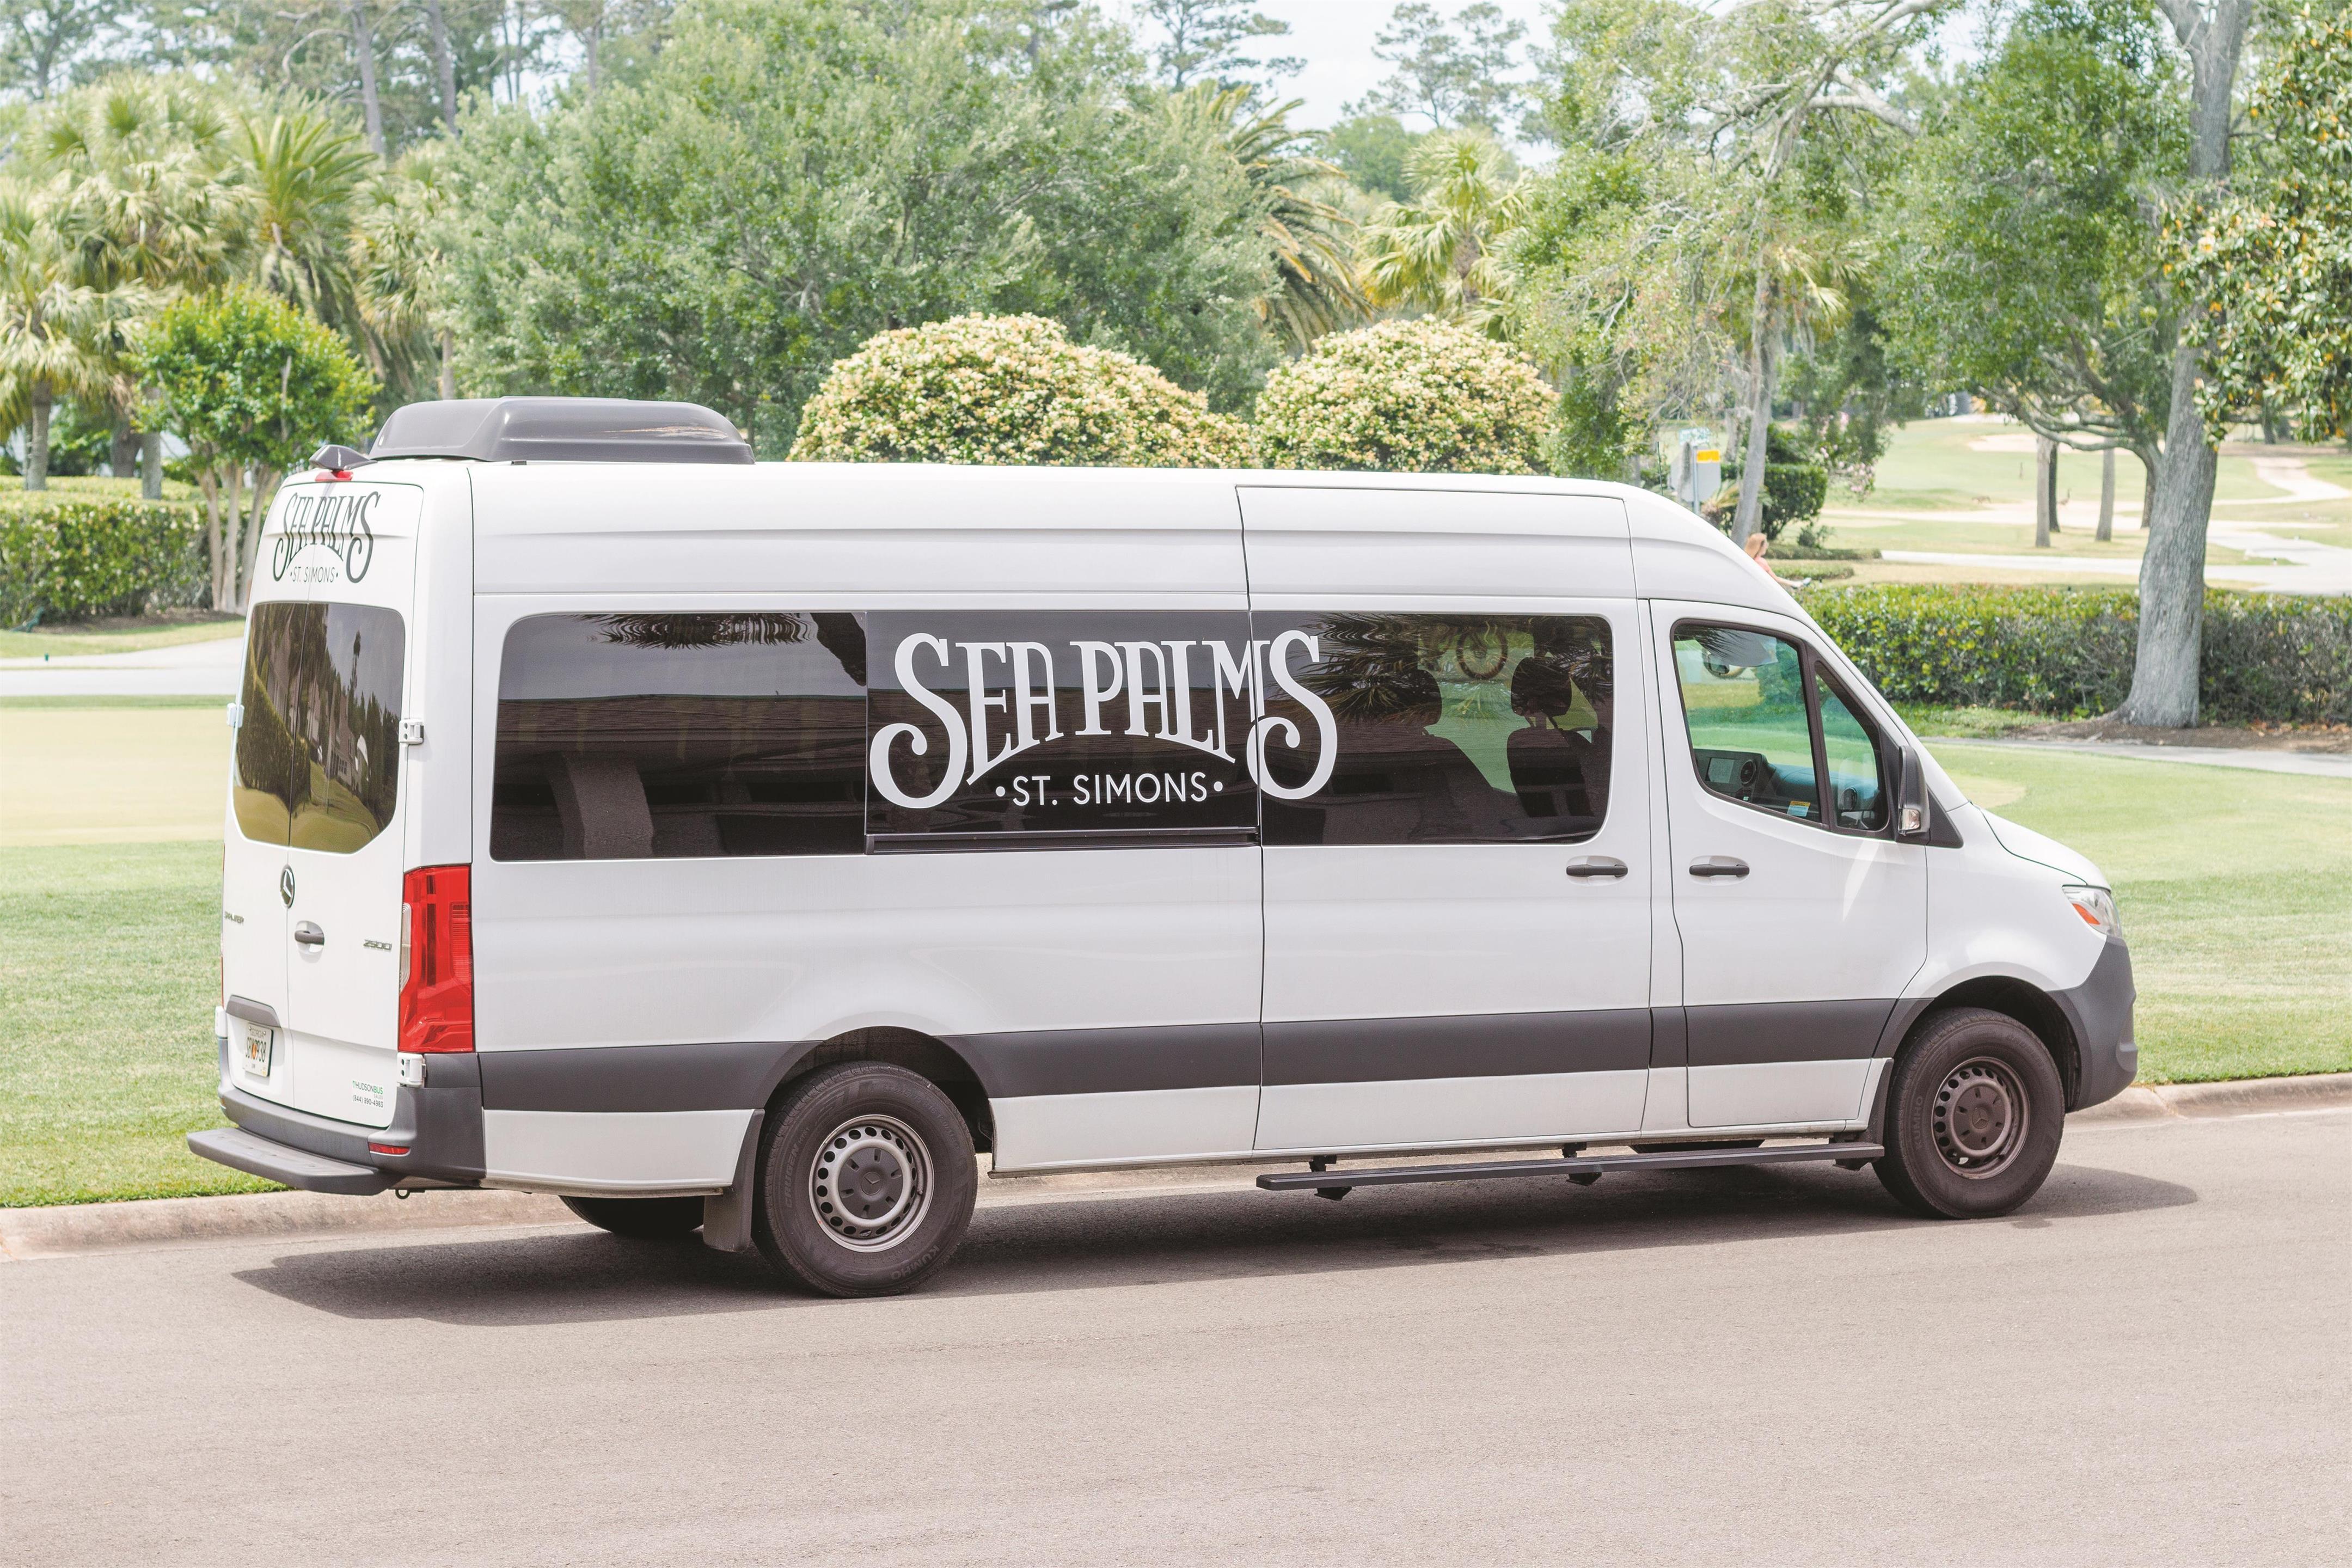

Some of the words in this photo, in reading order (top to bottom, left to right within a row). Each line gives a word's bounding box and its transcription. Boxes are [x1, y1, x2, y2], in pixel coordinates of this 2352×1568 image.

[273, 492, 314, 581] SEA
[310, 491, 381, 583] PALMS
[292, 567, 301, 582] ST.
[303, 567, 335, 583] SIMONS
[869, 633, 1064, 809] SEA
[1070, 630, 1338, 799] PALMS
[1012, 775, 1058, 806] ST.
[1073, 771, 1208, 805] SIMONS
[363, 940, 392, 950] 2500
[891, 1245, 941, 1279] KUMHO
